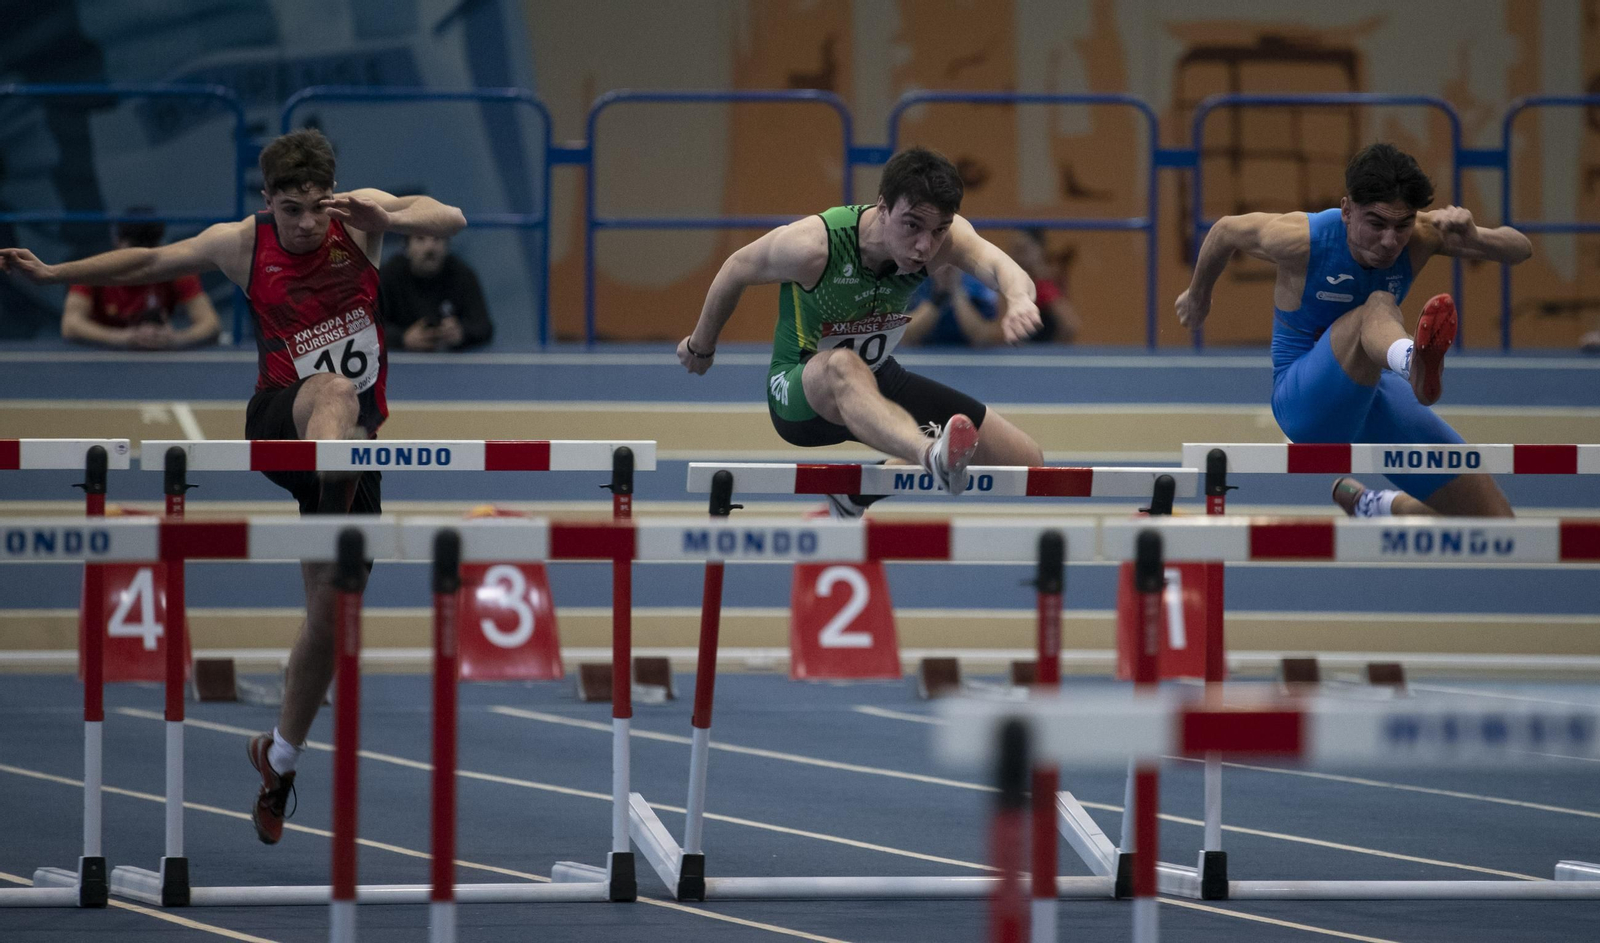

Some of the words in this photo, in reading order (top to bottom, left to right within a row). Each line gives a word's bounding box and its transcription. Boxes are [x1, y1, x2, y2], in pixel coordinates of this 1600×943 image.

[833, 277, 860, 285] VIATOR
[293, 329, 313, 344] XXI
[313, 316, 344, 336] COPA
[345, 307, 366, 323] ABS
[296, 327, 347, 355] OURENSE
[313, 338, 368, 379] 16
[351, 447, 452, 467] MONDO
[1384, 450, 1481, 469] MONDO
[894, 473, 994, 491] MOO
[4, 528, 111, 555] ONDO
[682, 529, 818, 555] MONDO
[107, 566, 164, 651] 4
[480, 564, 535, 649] 3
[815, 565, 874, 649] 2
[1163, 567, 1188, 650] 1
